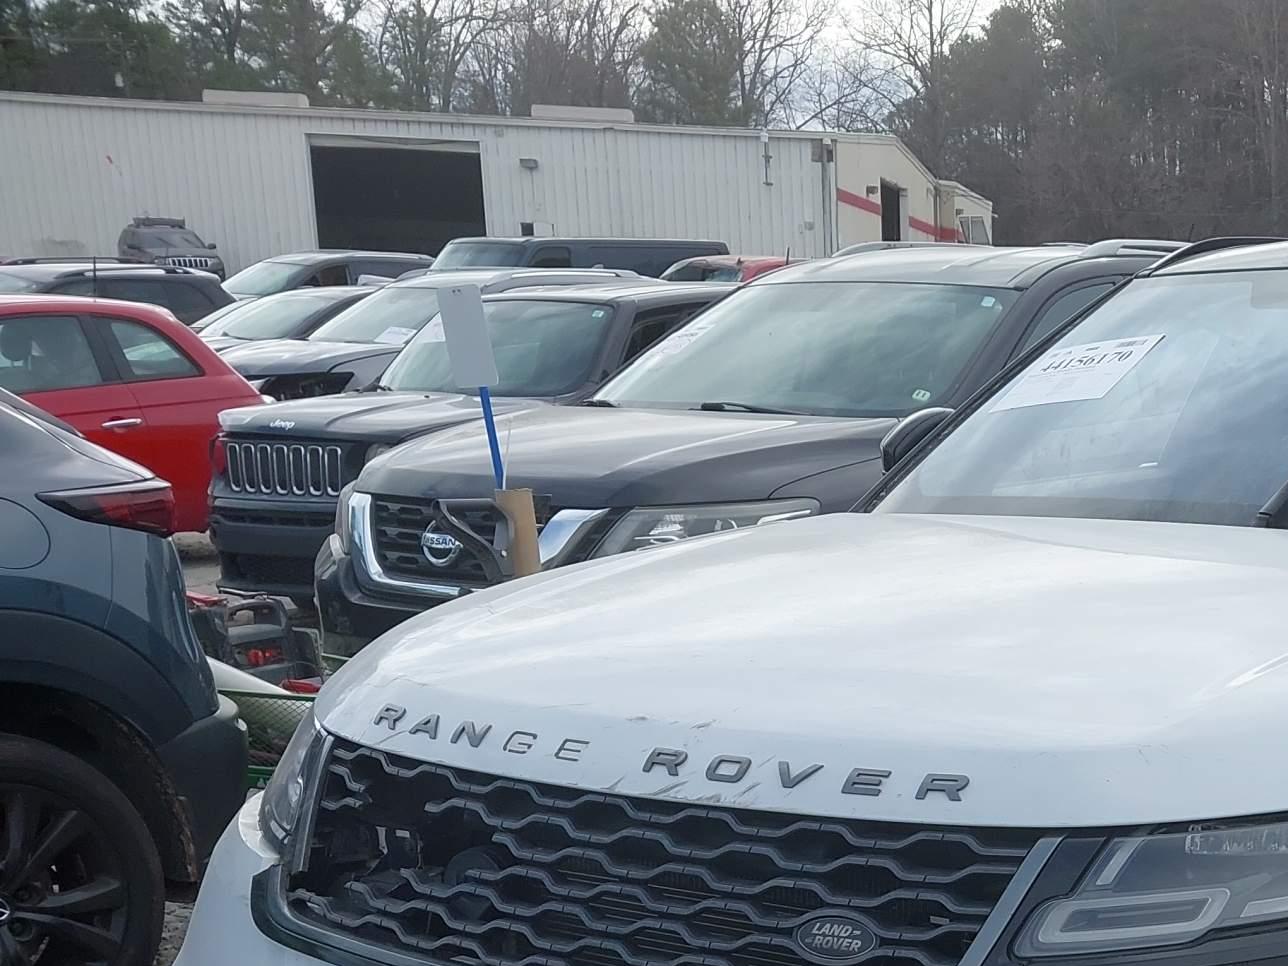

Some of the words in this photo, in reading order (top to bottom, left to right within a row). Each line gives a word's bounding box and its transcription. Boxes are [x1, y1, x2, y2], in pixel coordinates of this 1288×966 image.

[1040, 350, 1134, 373] 44156170
[270, 419, 296, 431] Jeep
[373, 703, 591, 762] RANGE
[642, 746, 970, 802] ROVER
[811, 922, 852, 937] LAND
[812, 935, 862, 952] ROVER
